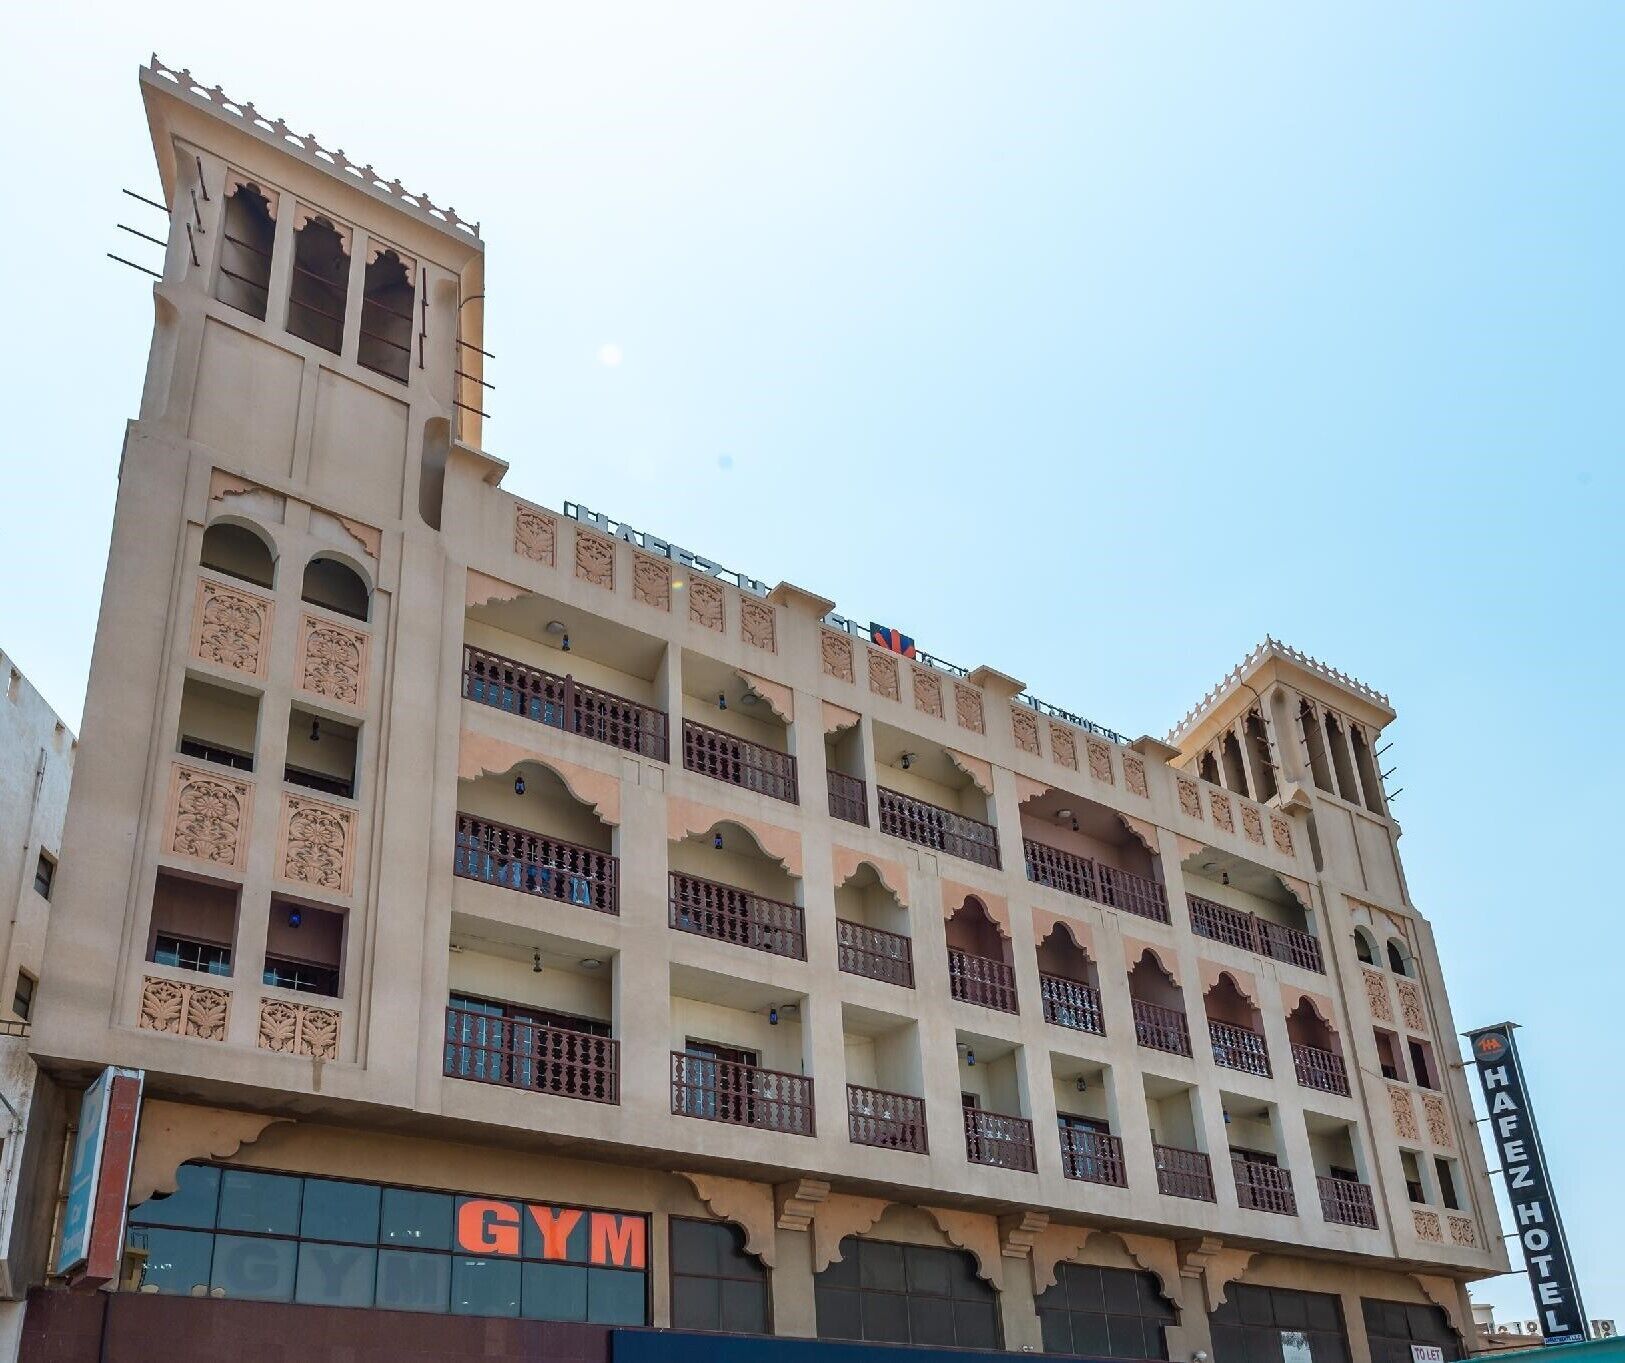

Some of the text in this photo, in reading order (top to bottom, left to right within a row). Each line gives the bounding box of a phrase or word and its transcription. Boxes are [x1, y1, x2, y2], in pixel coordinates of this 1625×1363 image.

[1483, 1065, 1535, 1189] HAFEZ
[1516, 1201, 1569, 1333] HOTEL
[458, 1200, 646, 1270] GYM
[1414, 1347, 1440, 1361] TO LET
